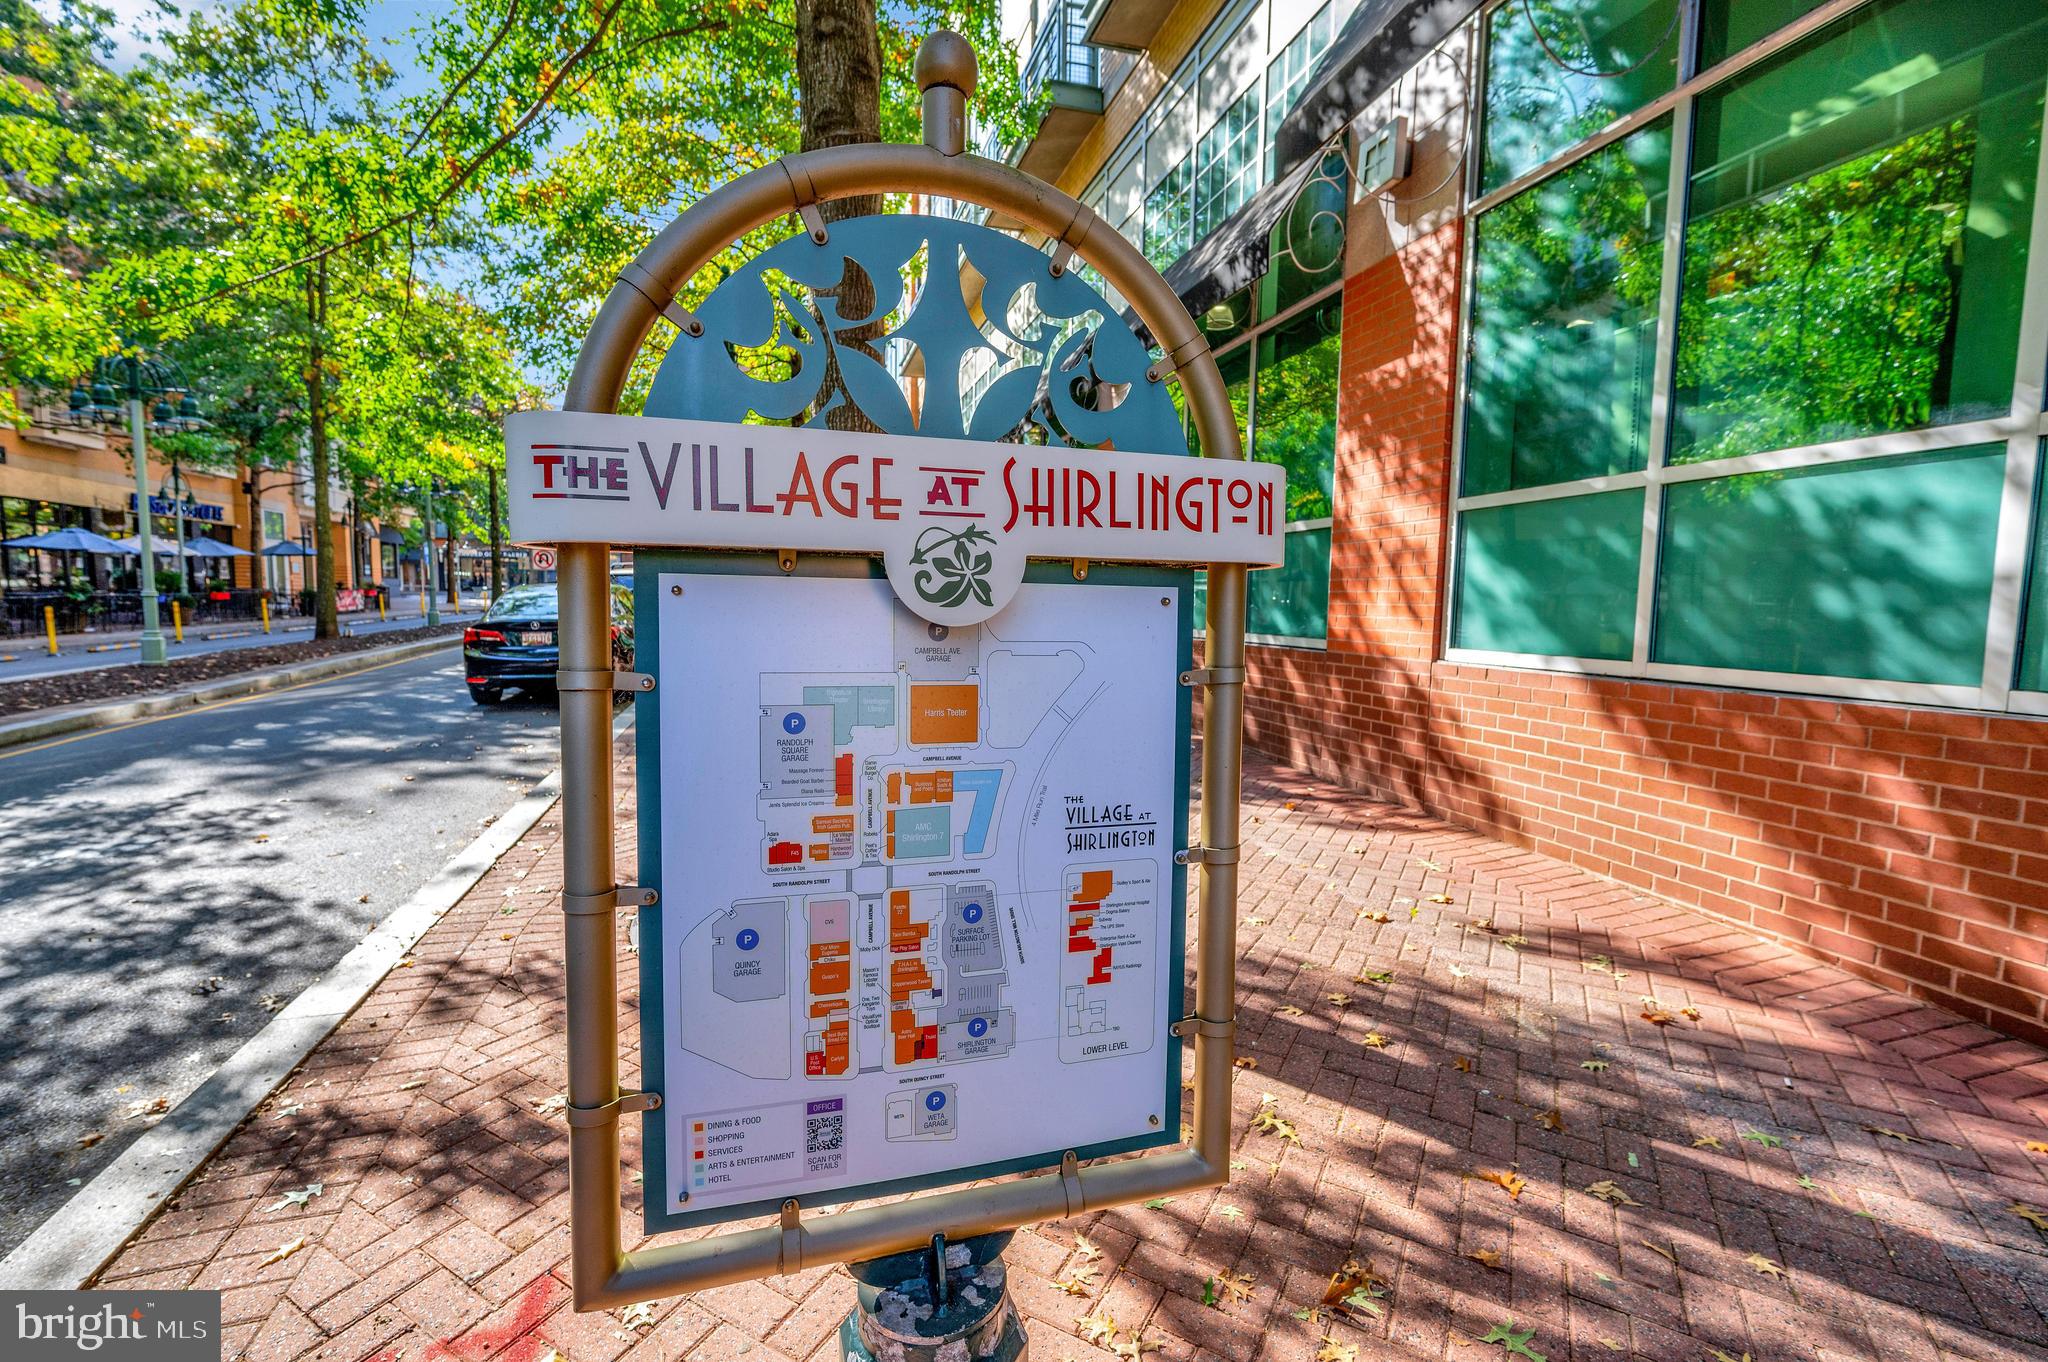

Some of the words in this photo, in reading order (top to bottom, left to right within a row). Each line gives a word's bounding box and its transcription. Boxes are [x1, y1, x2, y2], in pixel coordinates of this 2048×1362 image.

[533, 455, 630, 491] THE
[637, 441, 902, 521] VILLAGE
[926, 476, 979, 508] AT
[1003, 456, 1275, 536] SHIRLINGTON
[914, 647, 947, 655] CAMPBELL
[924, 708, 944, 717] Harris
[946, 707, 968, 717] Teeter
[776, 739, 814, 747] RANDOLPH
[781, 747, 809, 755] SQUARE
[781, 754, 809, 762] GARAGE
[1064, 796, 1084, 804] THE
[1066, 804, 1133, 824] VILLAGE
[1138, 812, 1152, 820] AT
[915, 822, 932, 831] AMC
[902, 832, 938, 843] Shirlington
[1067, 829, 1155, 854] SHIRLINGTON
[957, 926, 985, 936] SURFACE
[951, 934, 978, 943] PARKING
[979, 933, 990, 941] LOT
[734, 960, 761, 969] QUINCY
[733, 968, 762, 977] GARAGE
[957, 1038, 997, 1049] SHIRLINGTON
[1082, 1044, 1107, 1055] LOWER
[1108, 1041, 1129, 1052] LEVEL
[964, 1046, 989, 1055] GARAGE
[812, 1101, 836, 1112] OFFICE
[927, 1112, 945, 1121] WETA
[707, 1119, 733, 1131] DINING
[742, 1116, 762, 1125] FOOD
[923, 1119, 949, 1129] GARAGE
[707, 1132, 745, 1144] SHOPPING
[707, 1146, 743, 1158] SERVICES
[708, 1160, 728, 1171] ARTS
[737, 1151, 795, 1166] ENTERTAINMENT
[807, 1156, 827, 1165] SCAN
[828, 1153, 842, 1162] FOR
[810, 1162, 839, 1172] DETAILS
[708, 1174, 732, 1184] HOTEL
